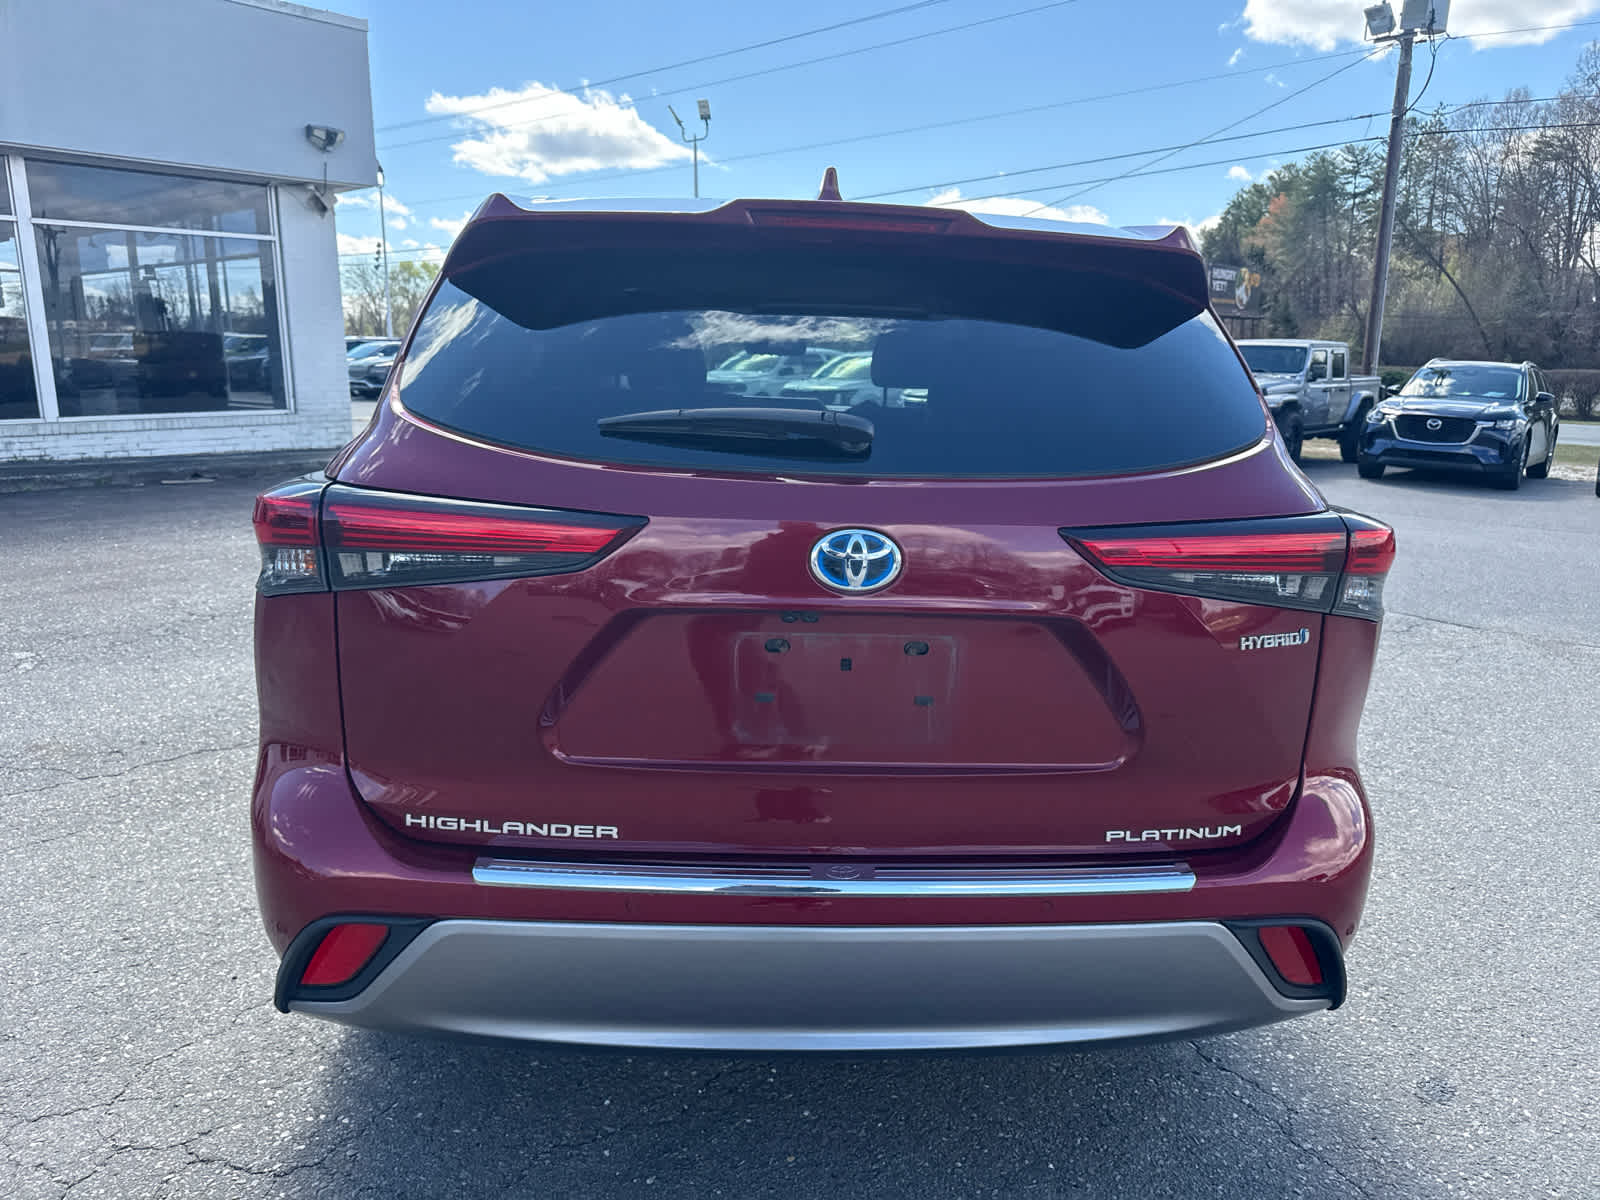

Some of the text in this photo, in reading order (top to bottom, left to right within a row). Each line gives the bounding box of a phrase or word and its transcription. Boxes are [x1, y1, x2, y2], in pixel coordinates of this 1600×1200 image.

[1240, 632, 1301, 650] HYBRID
[405, 813, 619, 839] HIGHLANDER
[1105, 824, 1242, 842] PLATINUM
